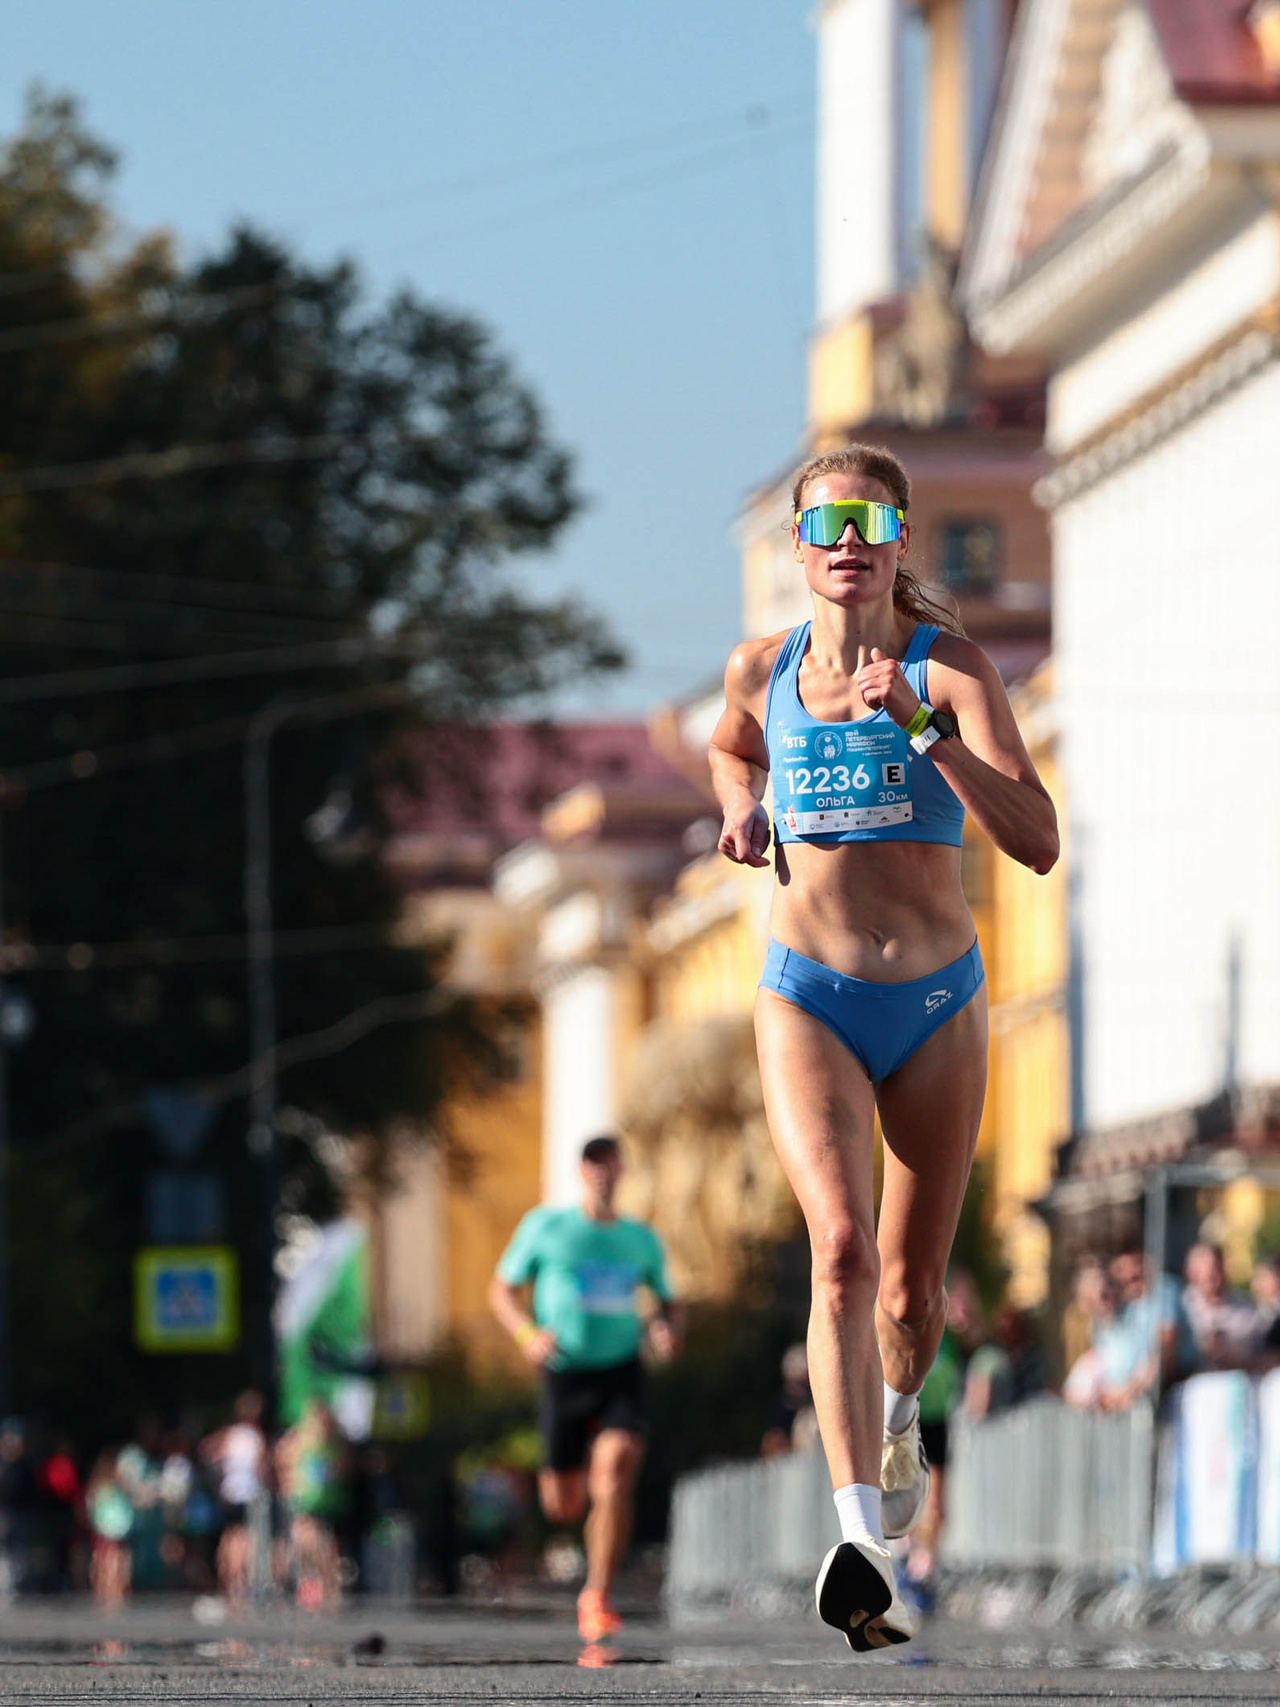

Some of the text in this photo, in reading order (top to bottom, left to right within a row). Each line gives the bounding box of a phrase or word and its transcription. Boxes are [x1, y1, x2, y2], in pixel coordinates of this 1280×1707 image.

[786, 736, 807, 749] ВТБ
[785, 764, 871, 795] 12236
[887, 766, 901, 783] E
[816, 796, 856, 808] ОЛЬГА
